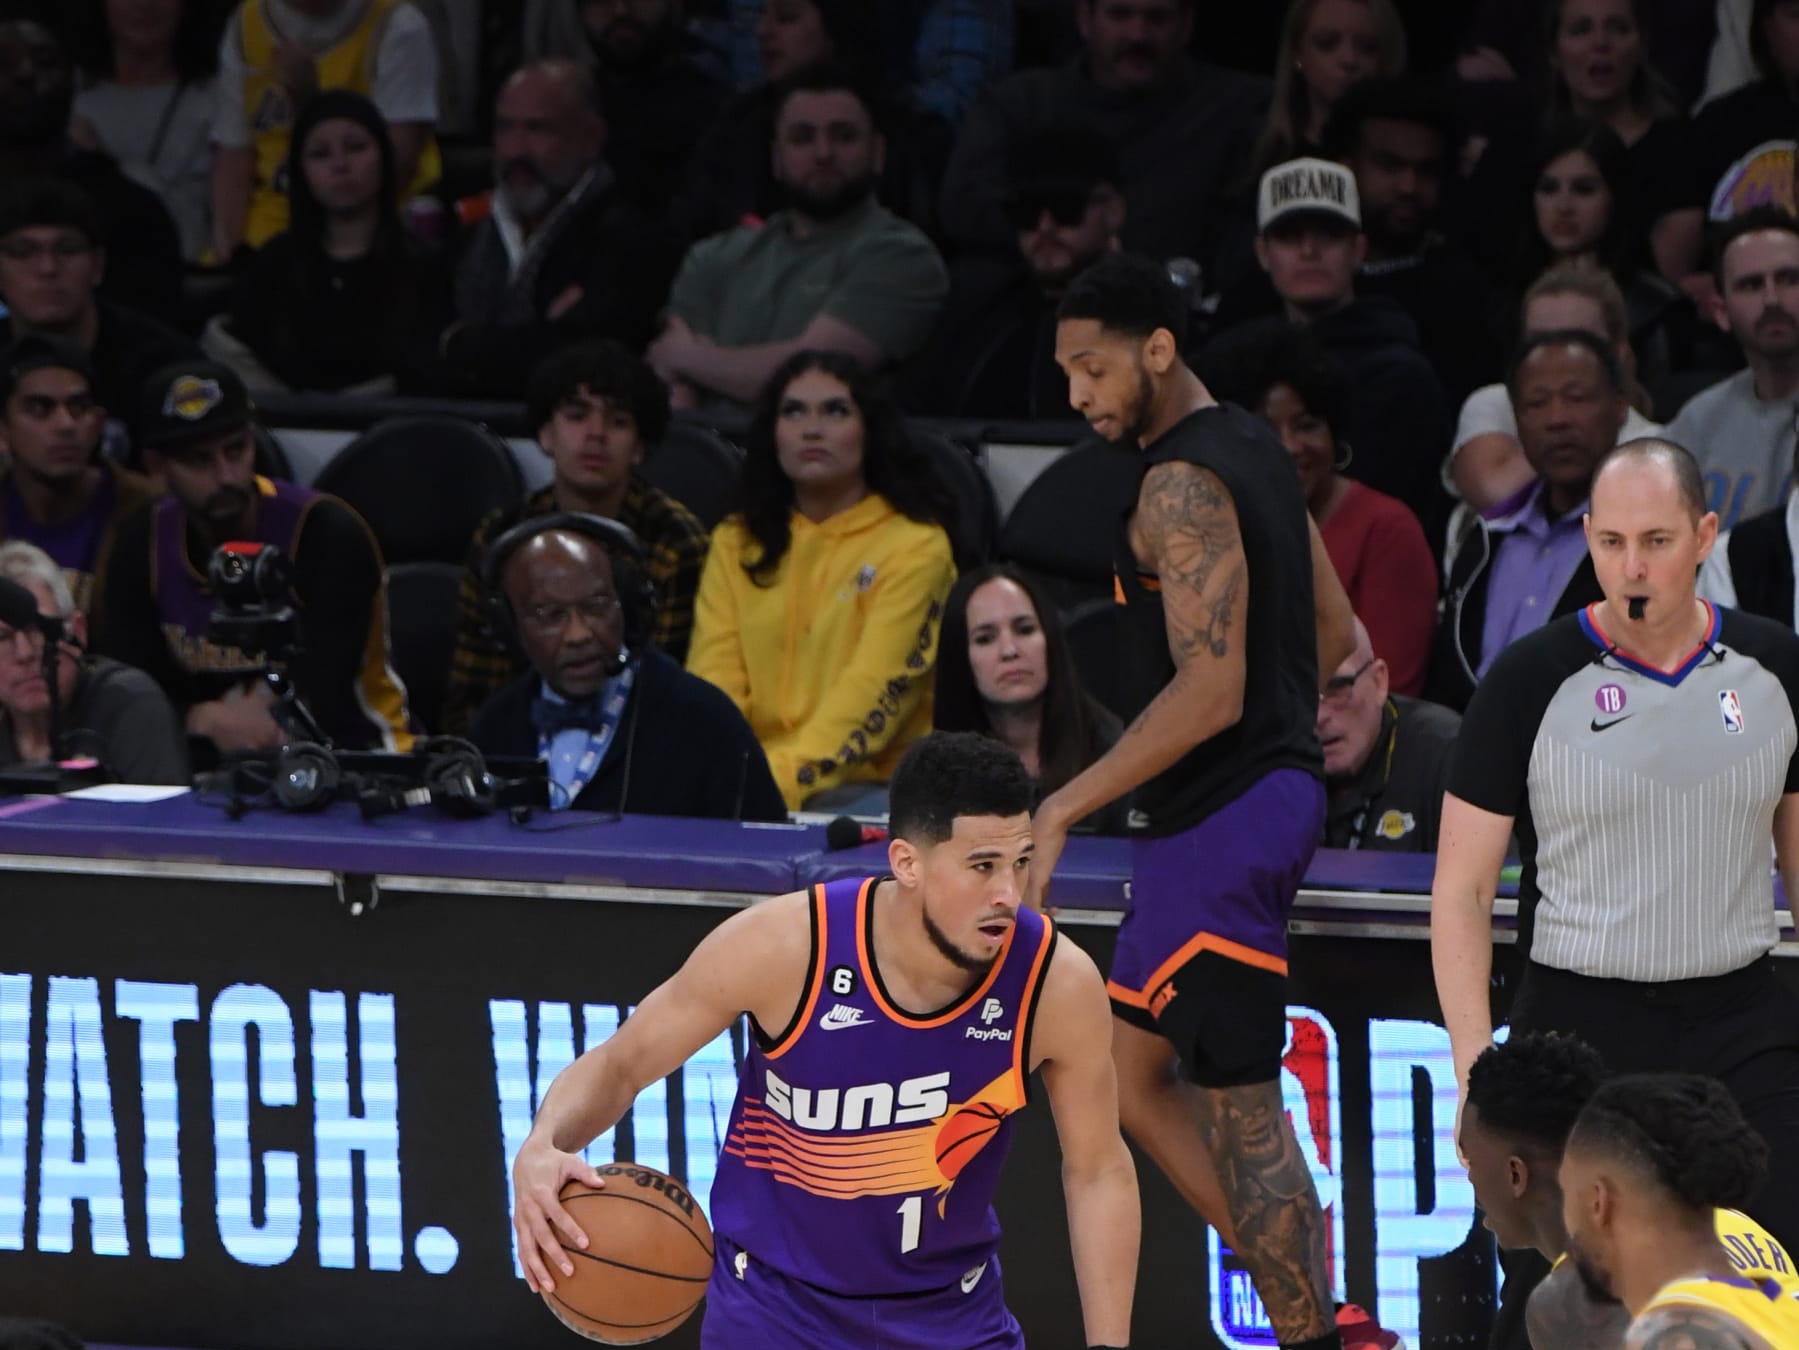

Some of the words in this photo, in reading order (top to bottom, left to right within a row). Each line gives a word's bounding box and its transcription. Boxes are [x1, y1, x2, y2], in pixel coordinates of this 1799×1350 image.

[832, 967, 854, 995] 6
[828, 1003, 865, 1023] NIKE
[964, 1026, 1013, 1042] PayPal
[0, 972, 460, 1275] ATCH.
[896, 1195, 923, 1255] 1
